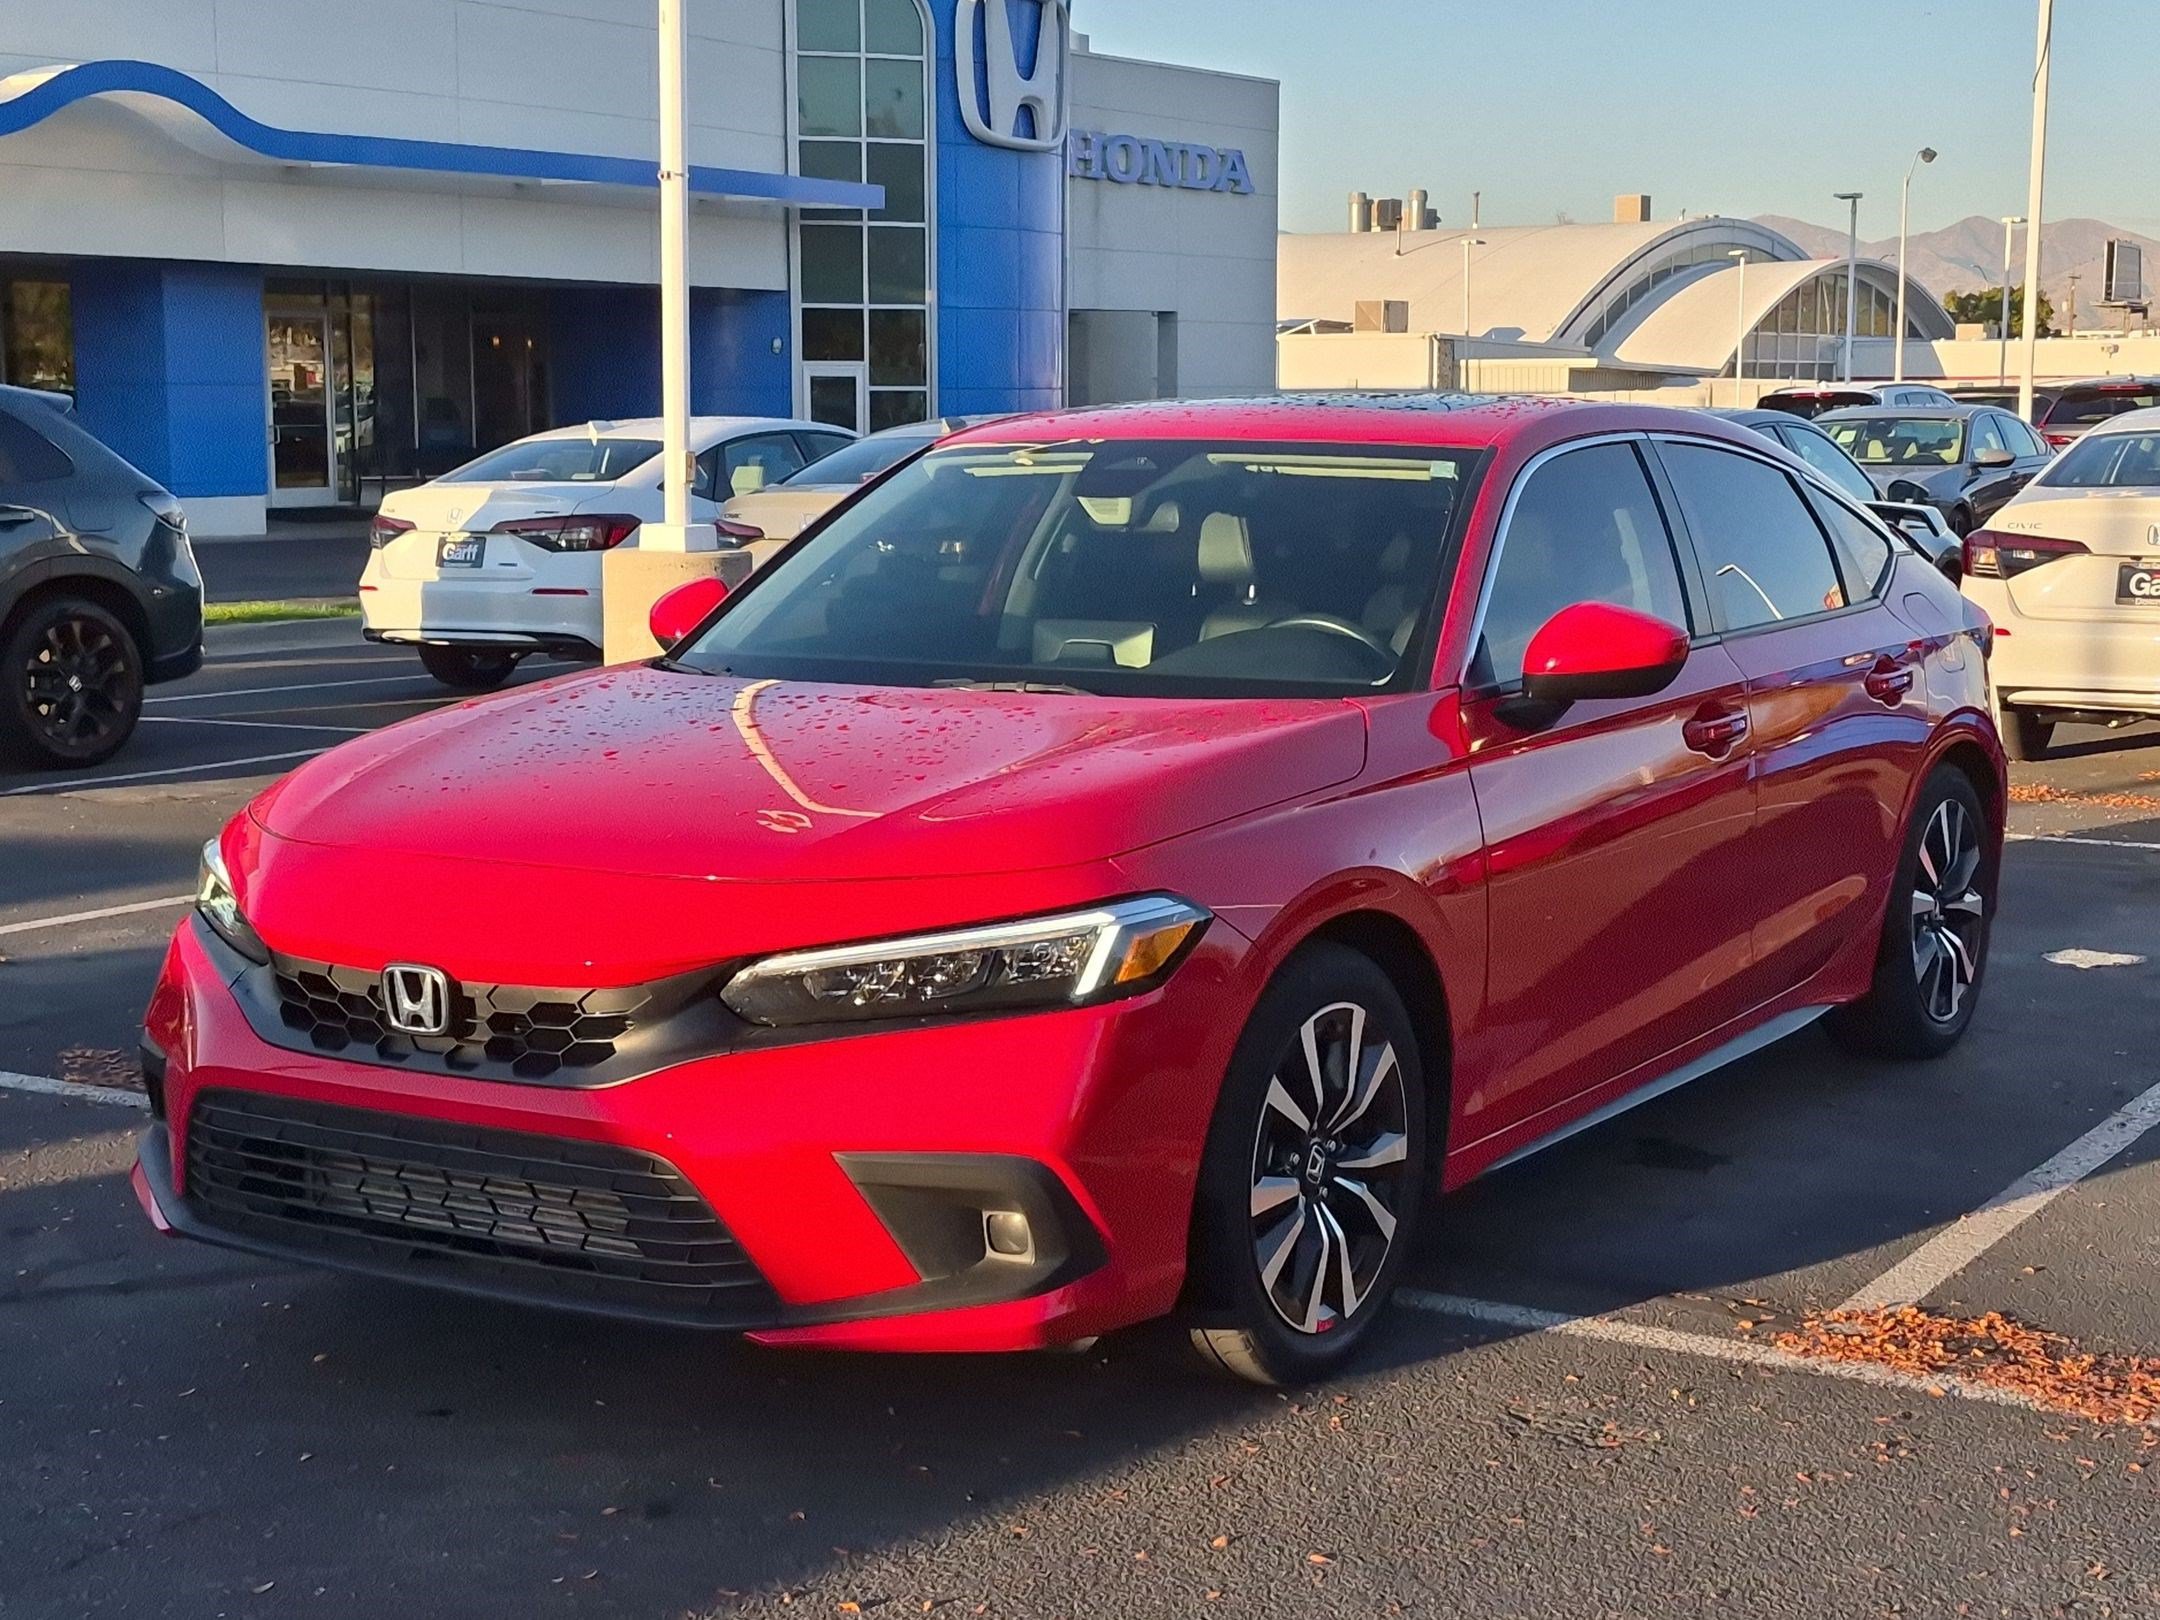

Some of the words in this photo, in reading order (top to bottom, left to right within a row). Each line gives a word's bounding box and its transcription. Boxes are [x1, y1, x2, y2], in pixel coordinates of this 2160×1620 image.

[1070, 128, 1255, 195] HONDA
[2007, 522, 2043, 530] CIVIC
[442, 542, 479, 561] Garff
